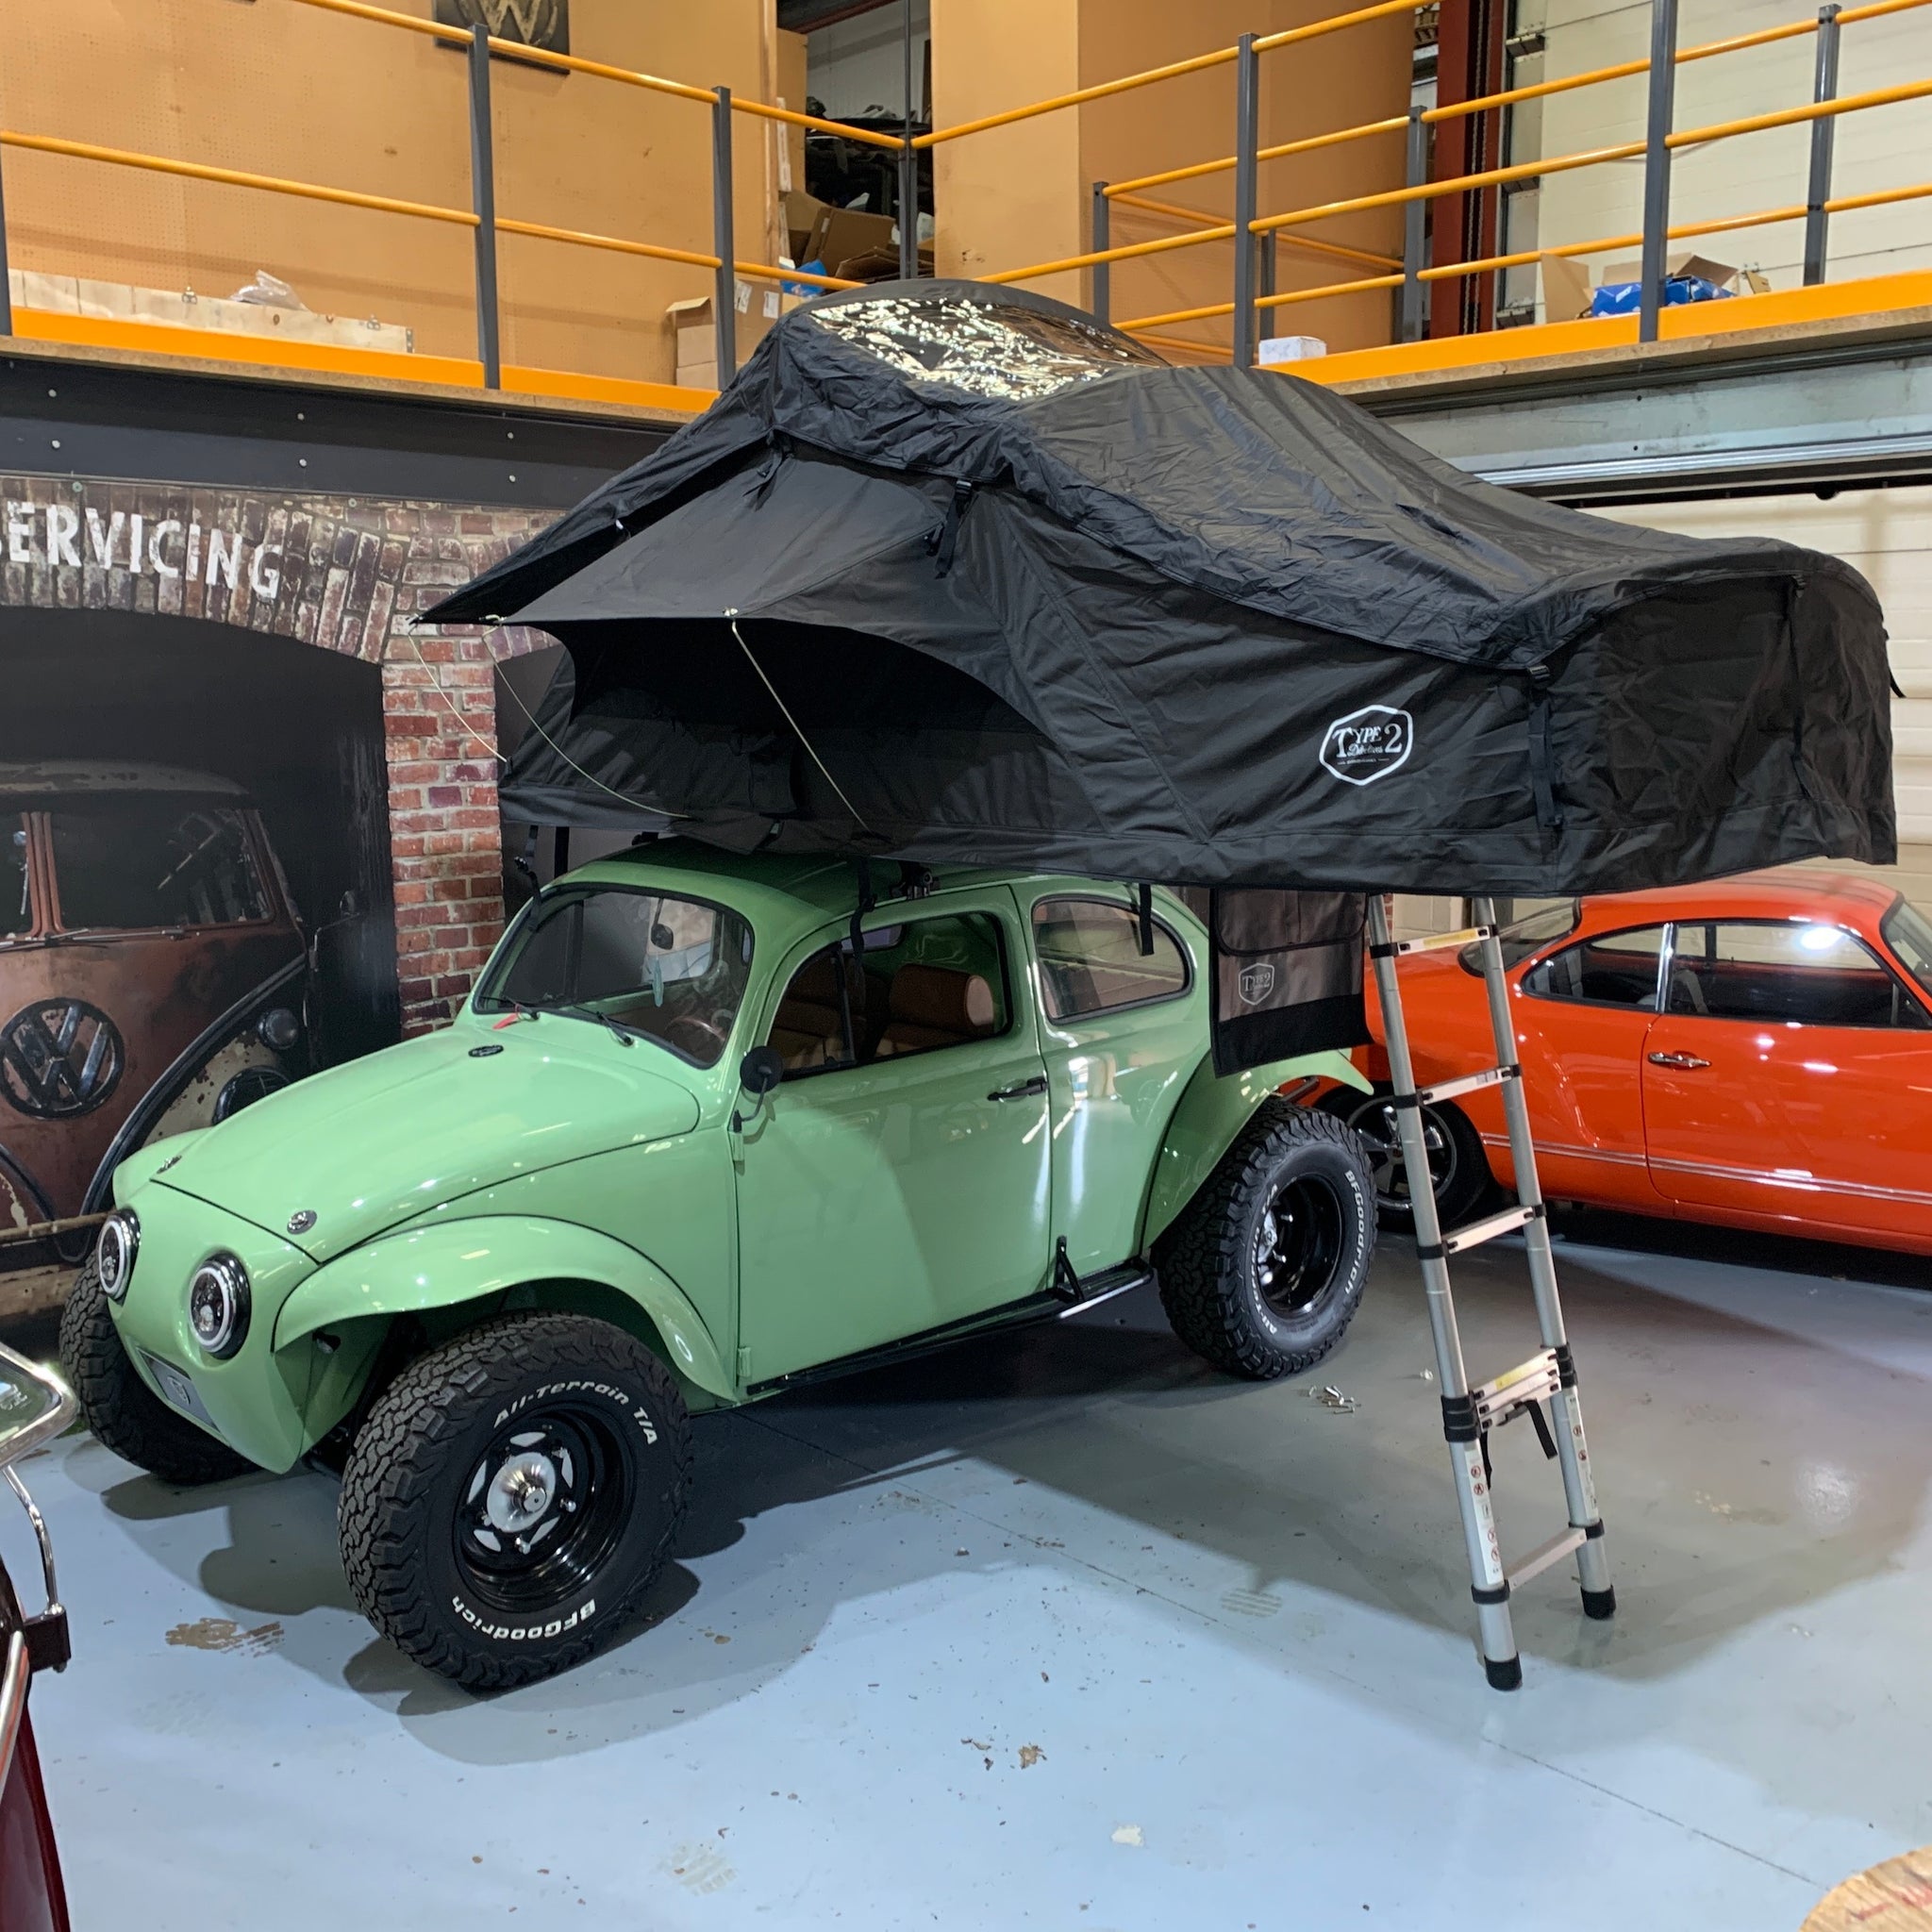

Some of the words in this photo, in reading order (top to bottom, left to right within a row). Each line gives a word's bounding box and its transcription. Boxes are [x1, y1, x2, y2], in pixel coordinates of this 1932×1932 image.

[0, 500, 282, 599] ERVICING
[1384, 723, 1403, 754] 2
[1344, 1170, 1365, 1294] BFGoodrich
[493, 1380, 630, 1429] All-Terrain
[633, 1406, 658, 1445] T/A
[451, 1595, 596, 1641] BFGoodrich
